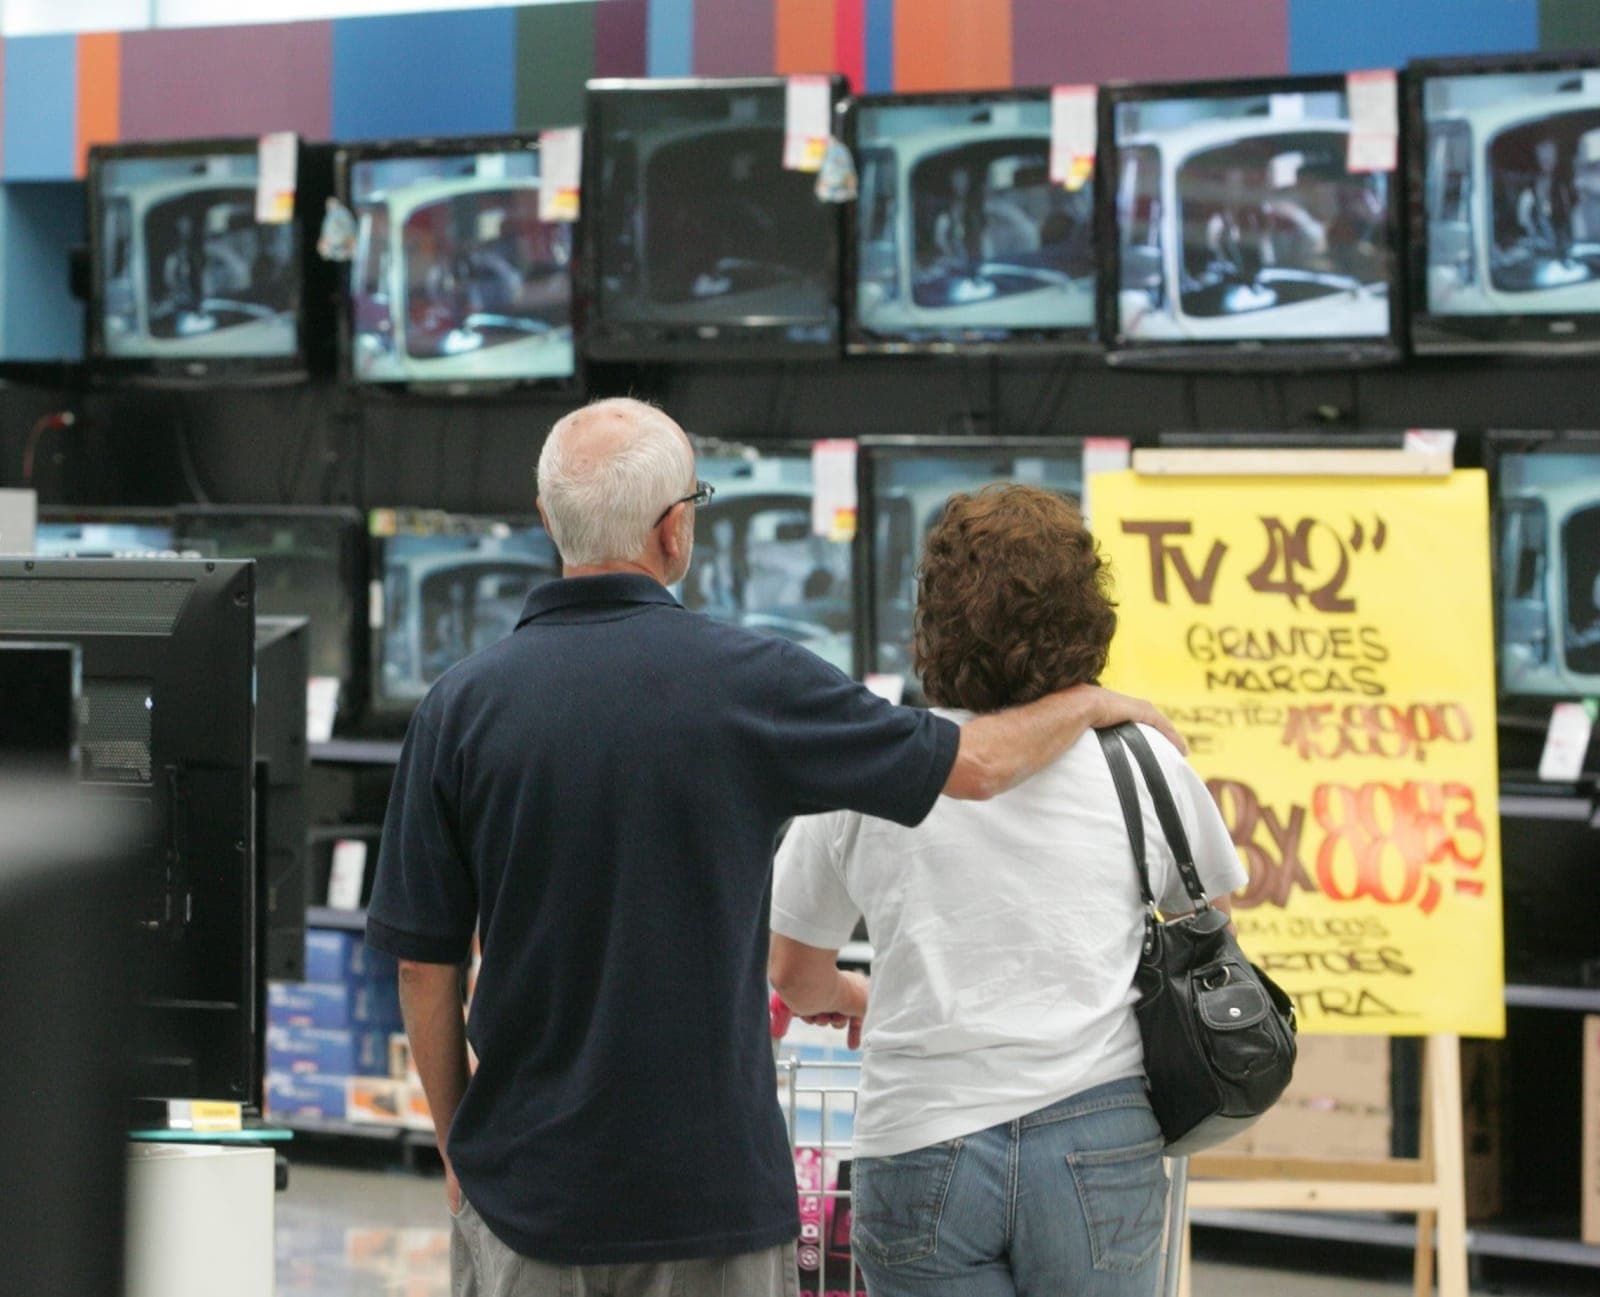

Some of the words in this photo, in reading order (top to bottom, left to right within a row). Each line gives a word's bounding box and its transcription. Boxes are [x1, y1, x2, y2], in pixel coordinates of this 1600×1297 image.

[1119, 518, 1229, 605] TV
[1186, 624, 1390, 664] GRANDES
[1206, 664, 1388, 696] MARCAS
[1233, 915, 1282, 937] EM
[1287, 915, 1390, 940] JUROS
[1290, 985, 1422, 1018] TRA
